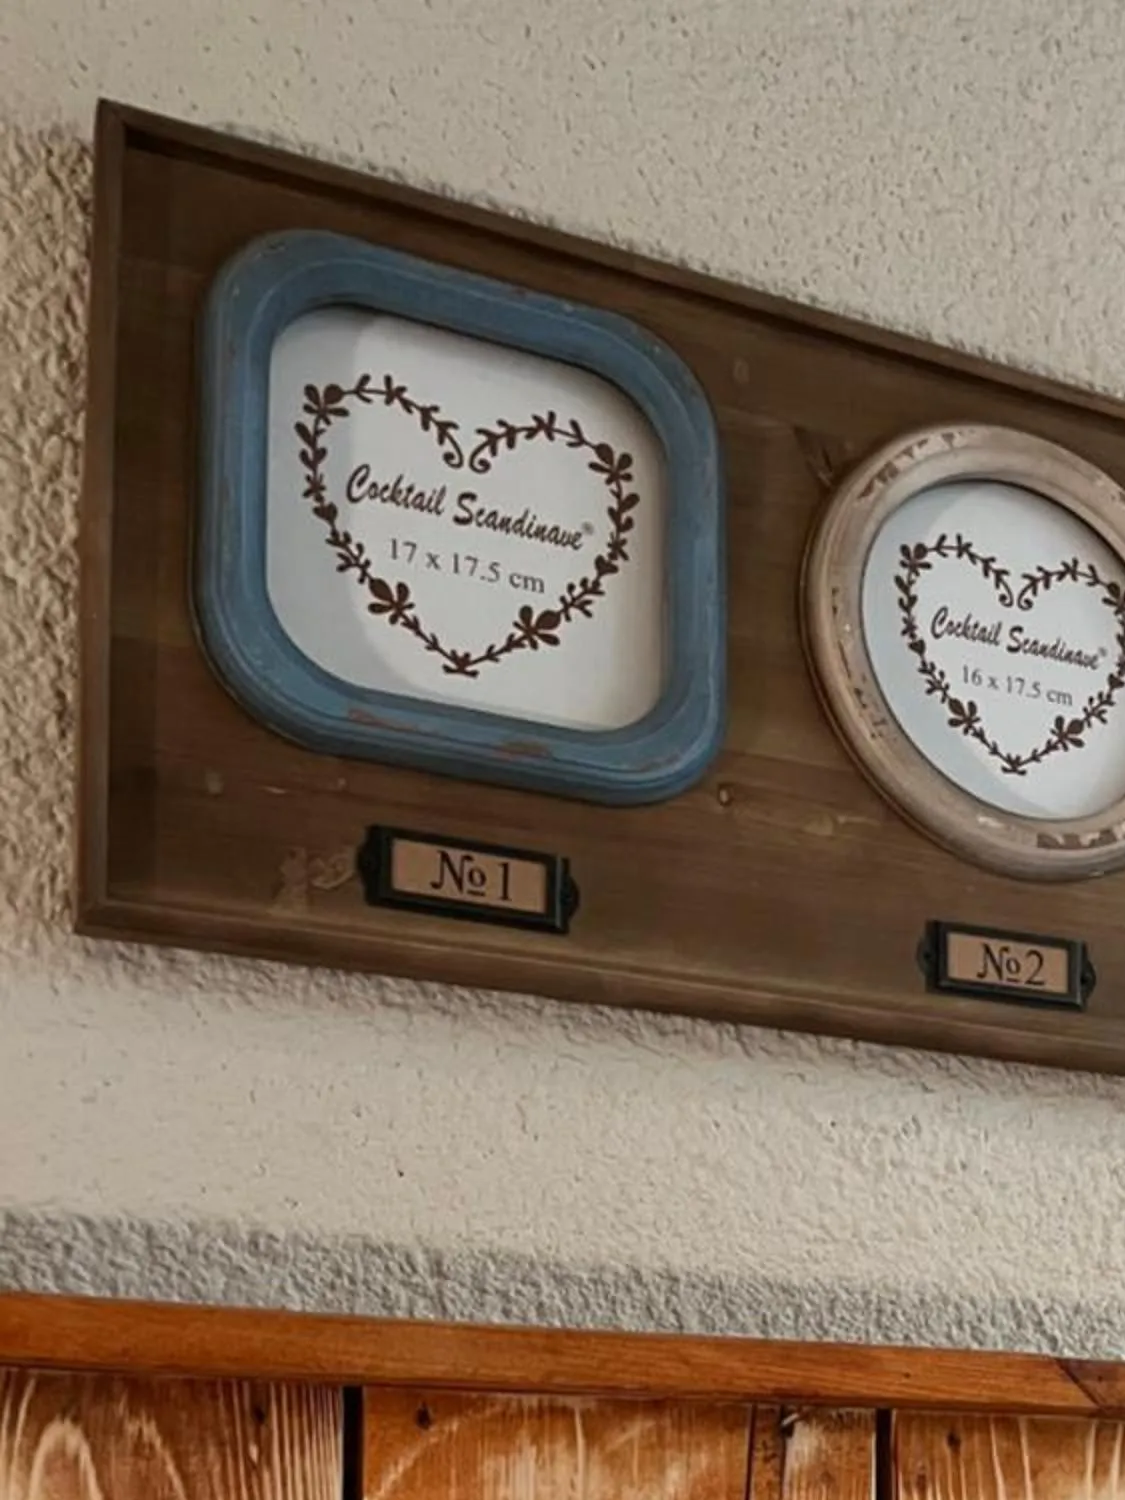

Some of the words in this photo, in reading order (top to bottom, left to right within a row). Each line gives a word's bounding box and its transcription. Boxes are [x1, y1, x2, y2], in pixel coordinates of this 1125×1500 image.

[346, 463, 447, 517] Cocktail
[391, 538, 418, 563] 17
[426, 552, 442, 570] x
[453, 552, 501, 584] 17.5
[509, 572, 546, 594] cm
[931, 606, 1003, 647] Cocktail
[962, 664, 984, 687] 16
[987, 676, 999, 691] x
[1006, 676, 1042, 699] 17.5
[1046, 689, 1073, 706] cm
